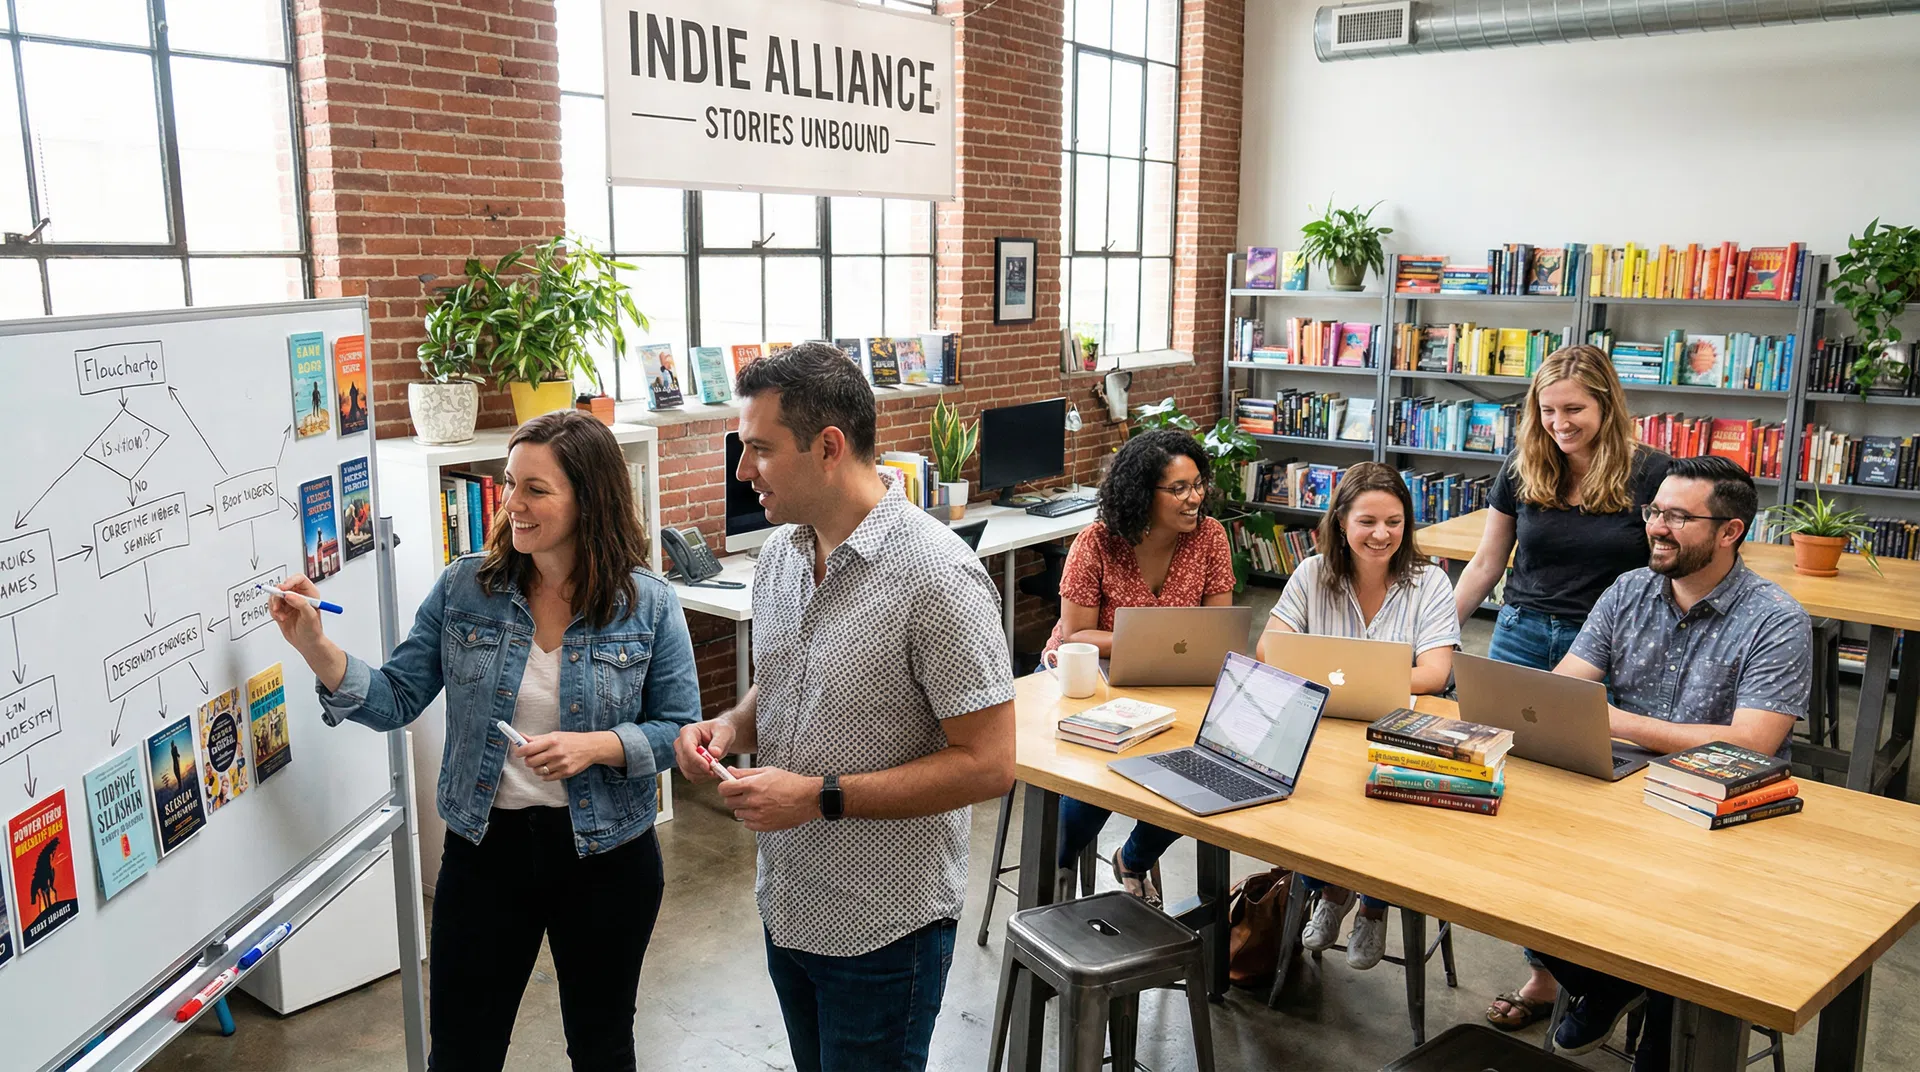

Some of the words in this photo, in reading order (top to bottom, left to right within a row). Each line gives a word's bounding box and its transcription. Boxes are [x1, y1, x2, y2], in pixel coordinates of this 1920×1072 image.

[629, 10, 751, 91] INDIE
[705, 105, 794, 146] STORIES
[801, 117, 889, 154] UNBOUND
[134, 480, 148, 494] NO
